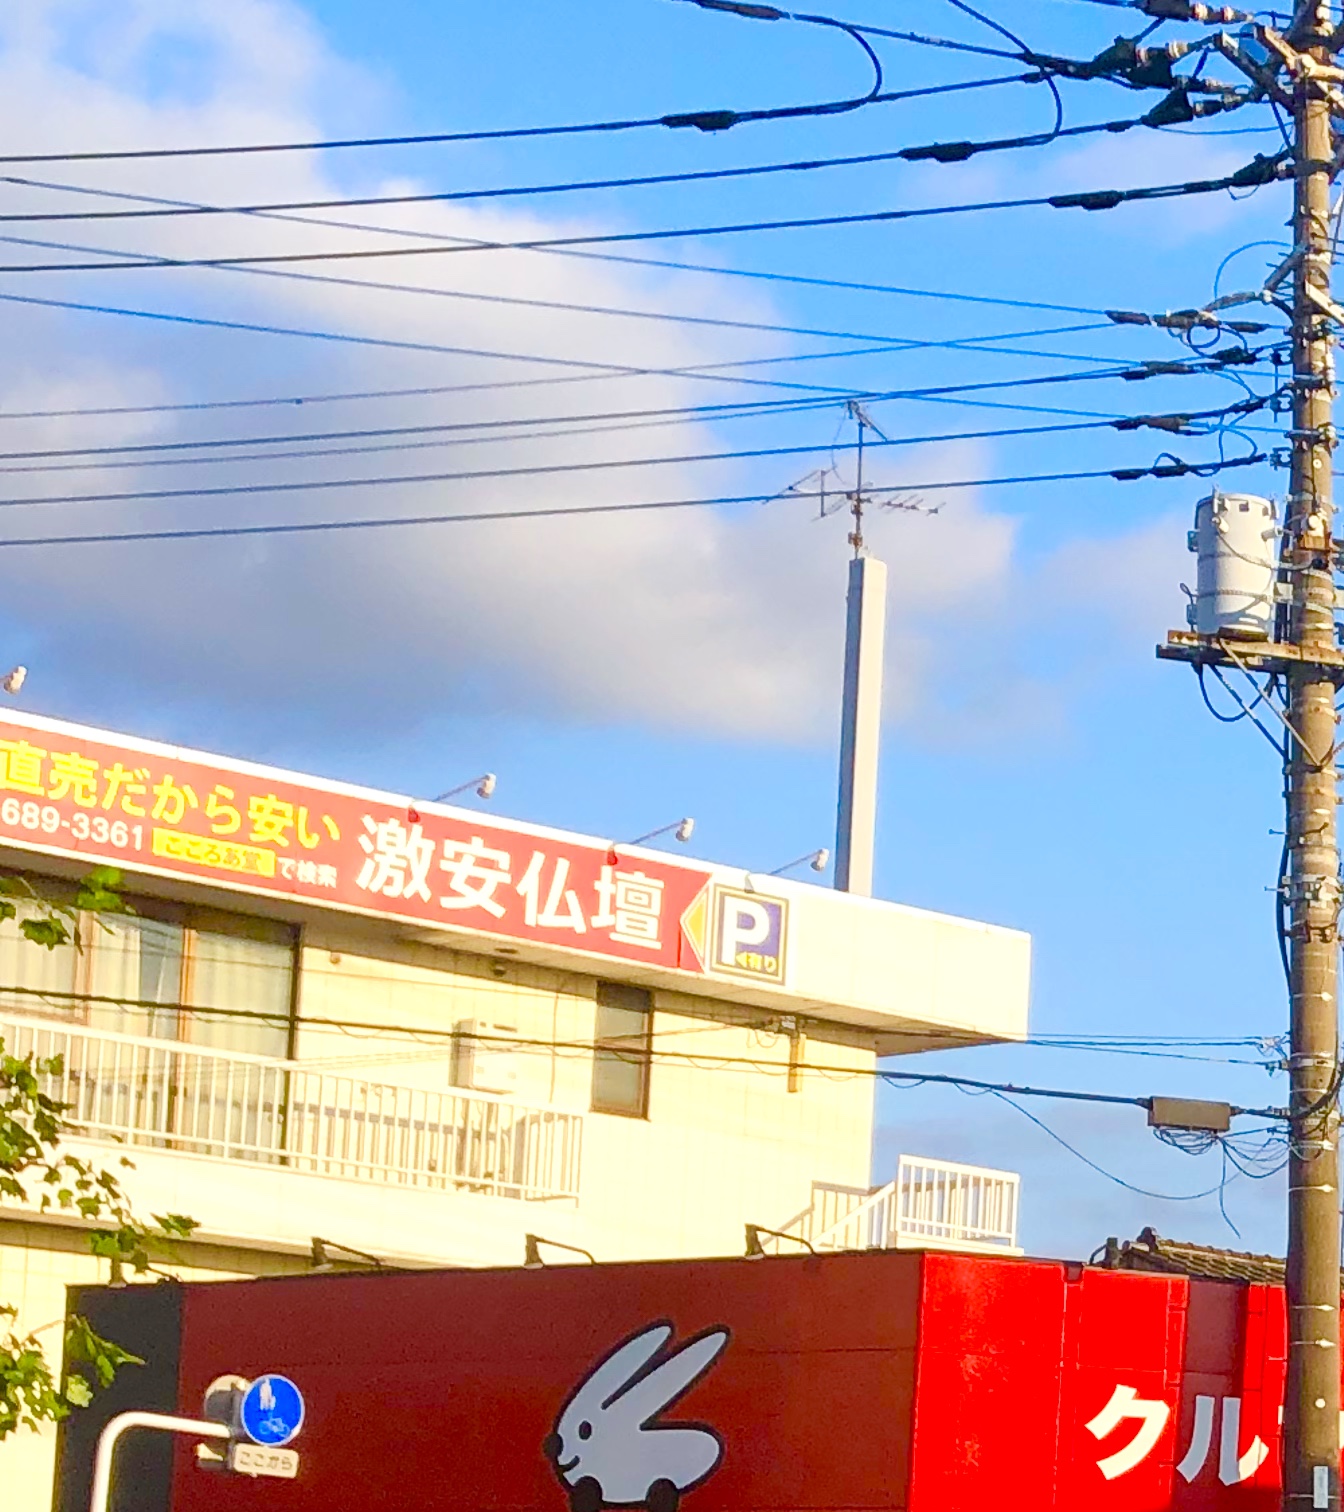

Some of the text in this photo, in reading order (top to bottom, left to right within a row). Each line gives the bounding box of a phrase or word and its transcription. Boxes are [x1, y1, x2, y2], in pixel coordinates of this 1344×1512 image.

[0, 739, 341, 850] 直売だから安い
[1, 797, 143, 851] 689-3361
[355, 814, 665, 950] 激安仏壇
[720, 894, 770, 966] P
[239, 1450, 293, 1471] ここから
